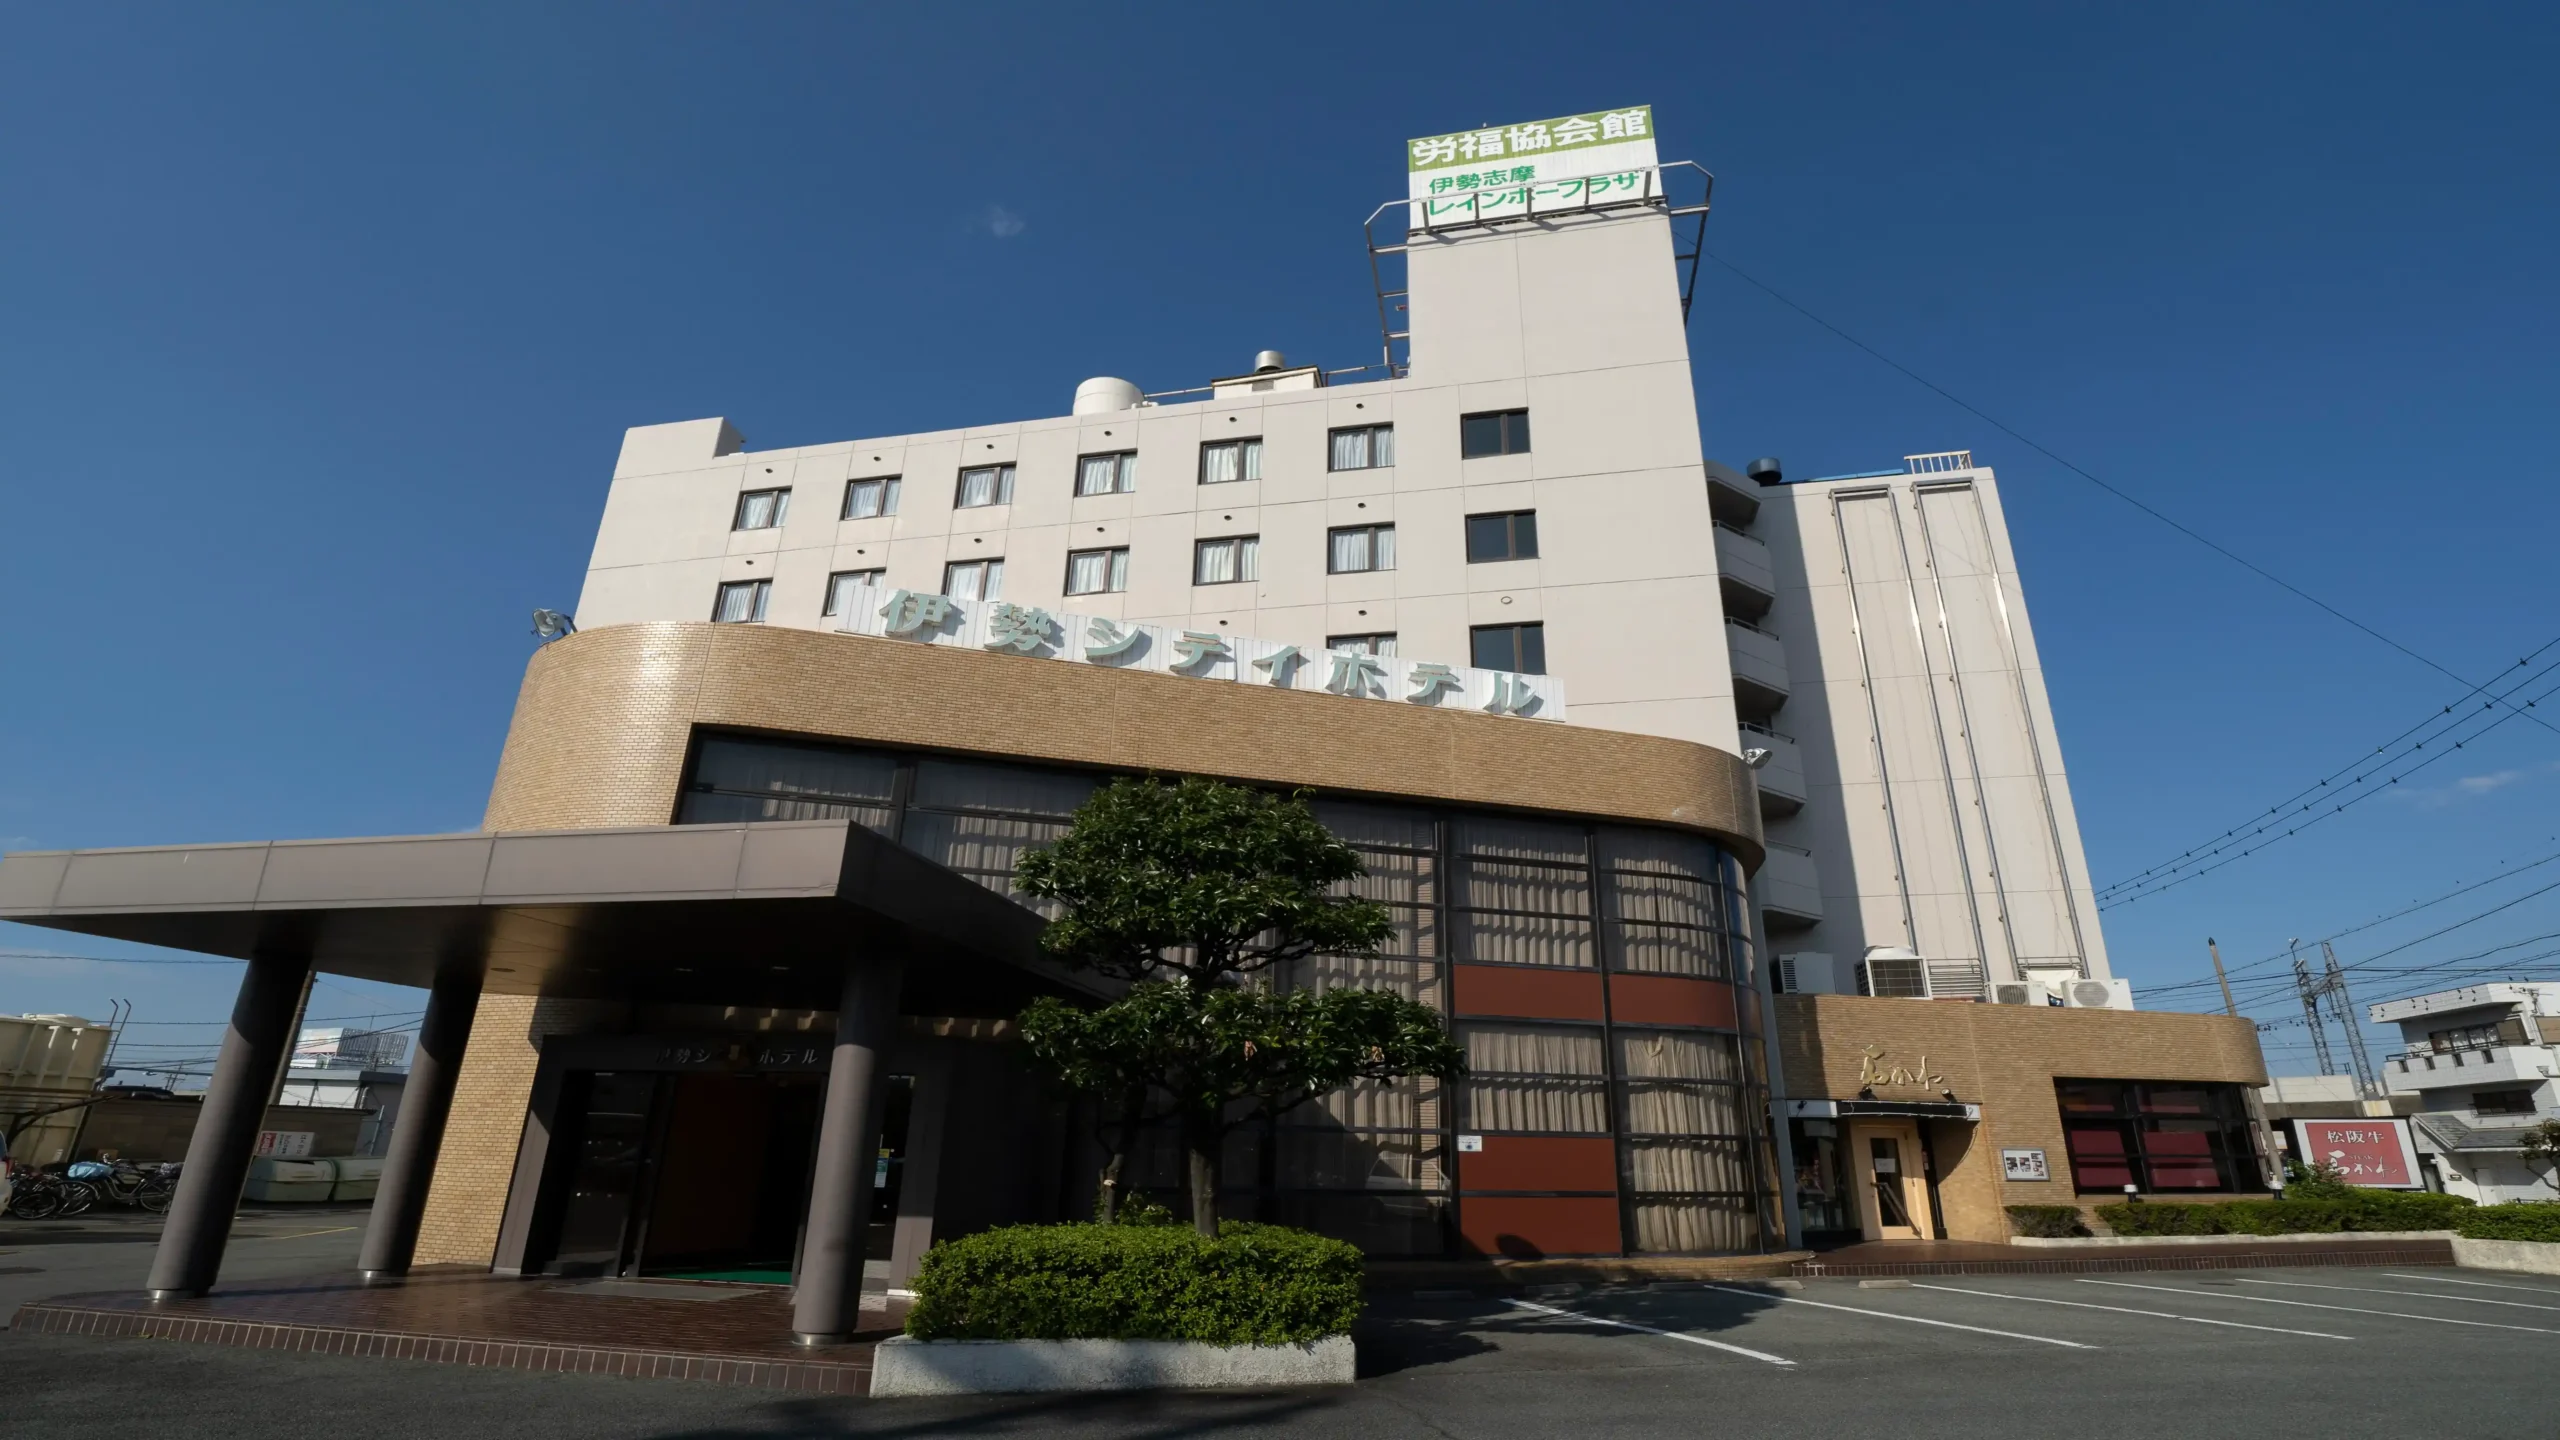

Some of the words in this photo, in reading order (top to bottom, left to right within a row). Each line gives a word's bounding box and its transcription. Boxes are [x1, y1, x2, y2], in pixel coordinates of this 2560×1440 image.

[1413, 110, 1646, 166] 労福協会館
[1429, 165, 1535, 194] 伊勢志摩
[2327, 1130, 2385, 1144] 松阪牛
